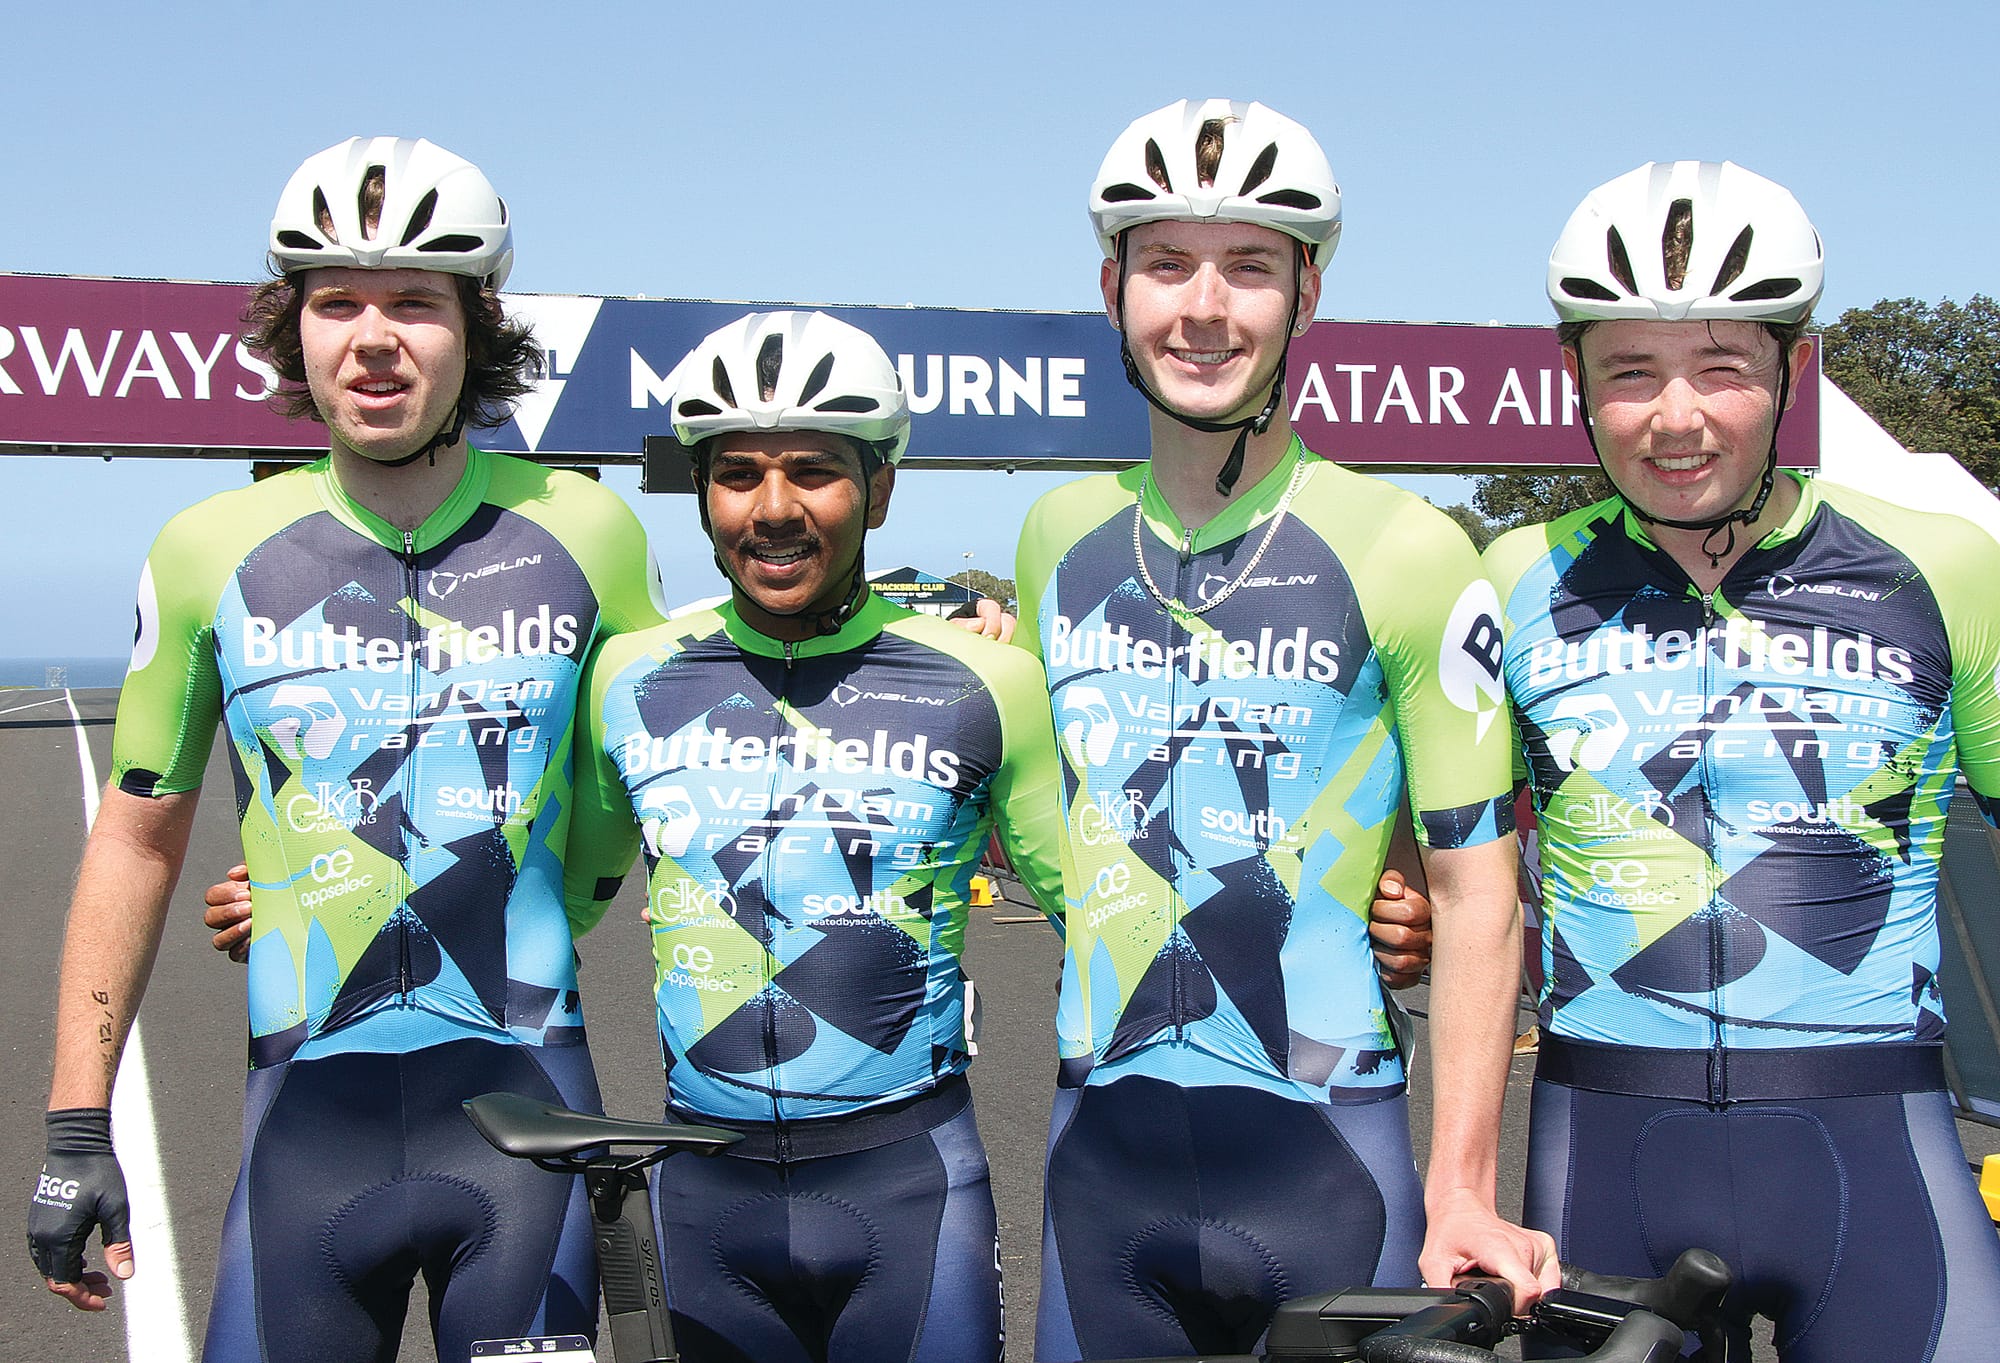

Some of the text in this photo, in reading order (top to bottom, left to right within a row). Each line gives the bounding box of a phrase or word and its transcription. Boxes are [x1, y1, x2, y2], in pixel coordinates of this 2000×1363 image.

[630, 346, 1087, 417] MURNE
[1289, 362, 1470, 425] ATAR
[921, 583, 945, 592] CLUB
[243, 604, 578, 674] Butterfields
[1050, 615, 1340, 683] Butterfields
[1527, 618, 1914, 687] Butterfields
[350, 726, 540, 753] racing
[623, 727, 961, 788] Butterfields
[1122, 742, 1302, 780] racing
[1632, 739, 1885, 769] racing
[704, 833, 924, 866] racing
[641, 1237, 661, 1308] syncros
